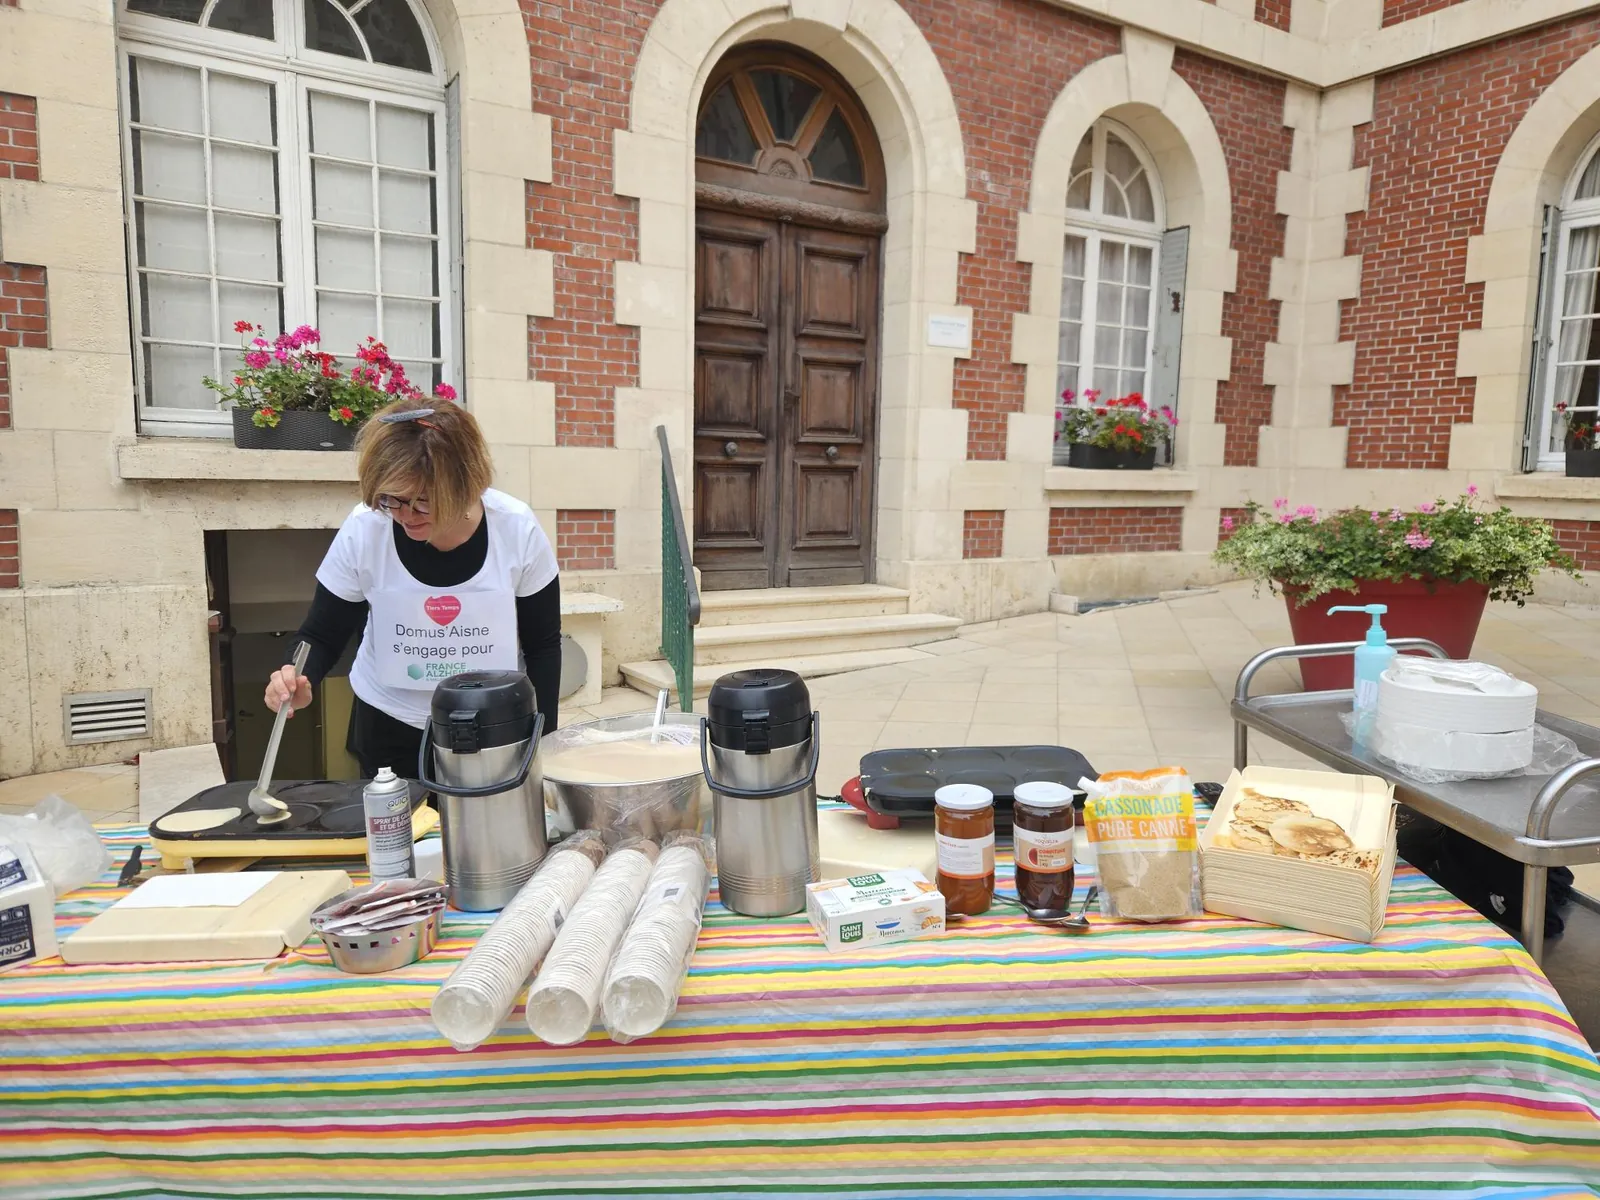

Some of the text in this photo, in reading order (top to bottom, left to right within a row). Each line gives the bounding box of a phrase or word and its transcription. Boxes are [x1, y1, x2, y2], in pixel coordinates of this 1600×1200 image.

[395, 623, 490, 638] Domus'Aisne
[393, 643, 494, 659] s'engage pour
[426, 662, 467, 670] FRANCE
[1094, 795, 1184, 817] CASSONADE
[373, 817, 391, 825] SPRAY
[392, 815, 401, 823] DE
[387, 822, 397, 830] DE
[1097, 817, 1188, 838] PURE CANNE
[849, 874, 880, 883] SAINT
[853, 877, 882, 887] LOUIS
[841, 924, 861, 933] SAINT
[841, 930, 862, 939] LOUIS
